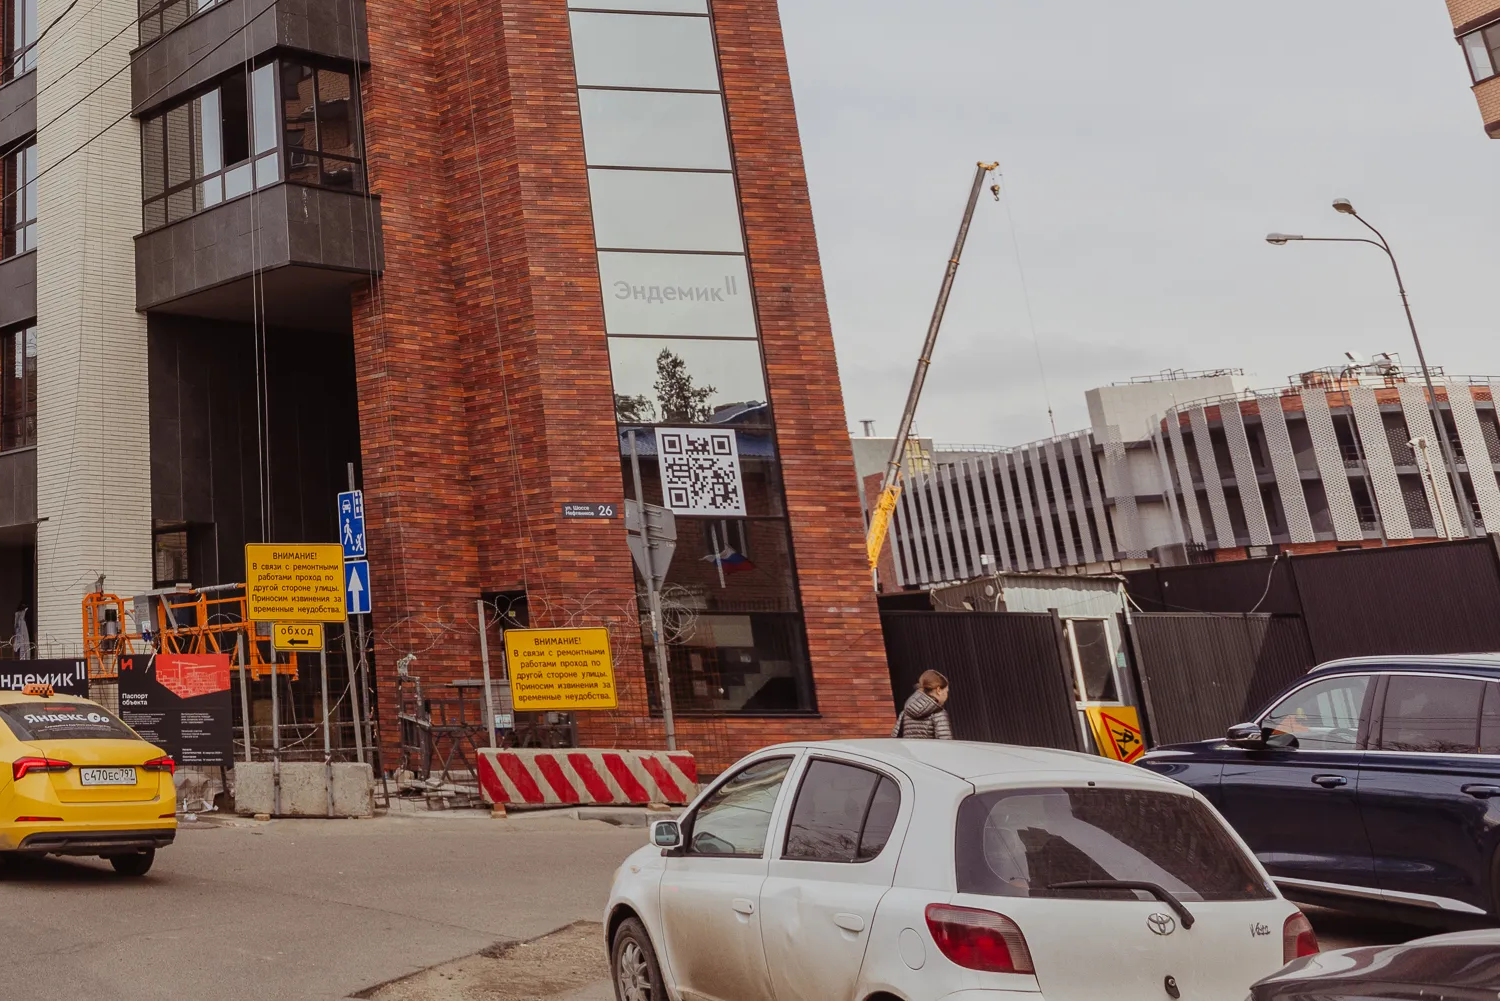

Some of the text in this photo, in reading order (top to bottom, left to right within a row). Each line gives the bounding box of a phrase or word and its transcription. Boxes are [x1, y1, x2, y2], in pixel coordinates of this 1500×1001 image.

[613, 280, 725, 304] Эндемик
[598, 505, 613, 516] 26
[272, 552, 317, 560] ВНИМАНИЕ!
[293, 564, 339, 572] ремонтными
[257, 573, 292, 582] работами
[253, 584, 340, 593] другой стороне улицы.
[252, 594, 288, 603] Приносим
[253, 605, 341, 614] временные неудобства.
[281, 626, 314, 636] обход
[534, 637, 581, 646] ВНИМАНИЕ!
[513, 649, 519, 657] В
[556, 649, 605, 657] ремонтными
[520, 660, 557, 669] работами
[560, 660, 588, 668] проход
[516, 671, 608, 680] другой стороне улицы.
[515, 682, 554, 691] Приносим
[518, 692, 611, 702] временные неудобства.
[24, 712, 87, 724] Яндекс
